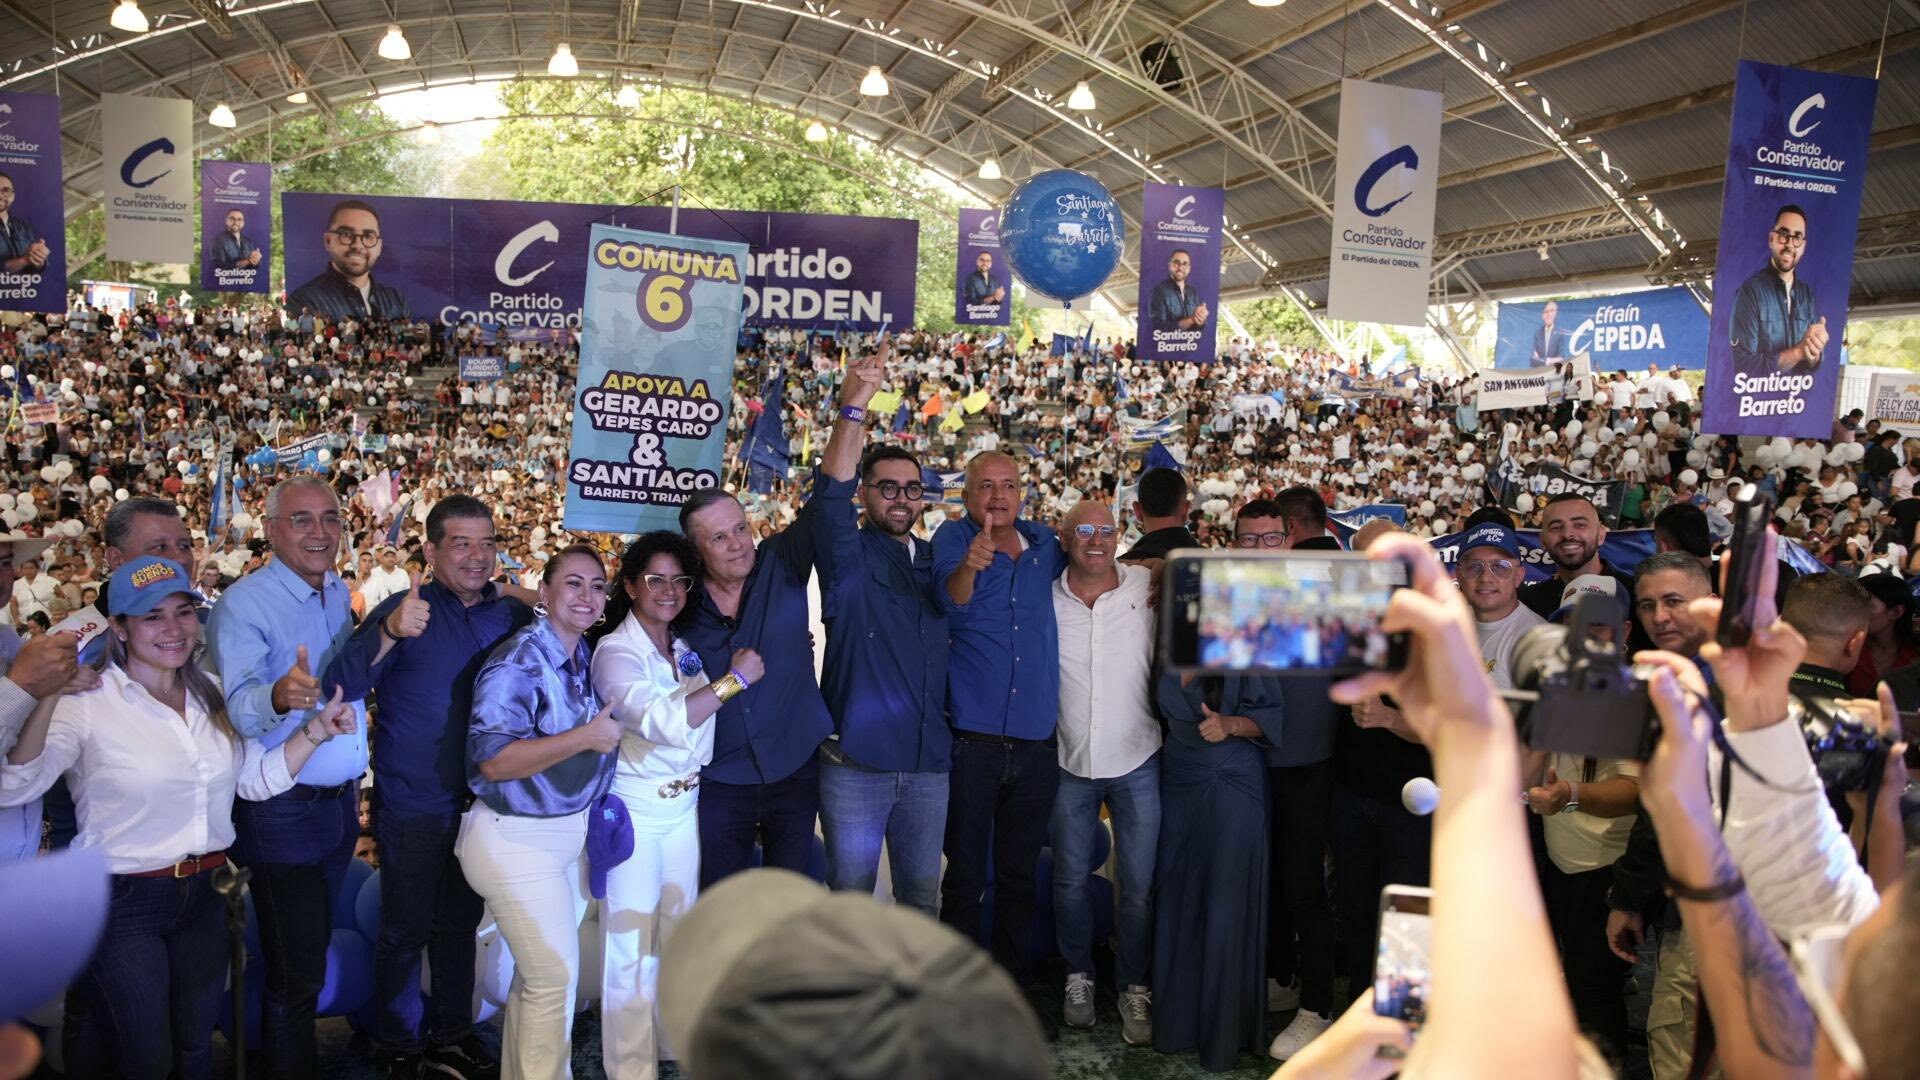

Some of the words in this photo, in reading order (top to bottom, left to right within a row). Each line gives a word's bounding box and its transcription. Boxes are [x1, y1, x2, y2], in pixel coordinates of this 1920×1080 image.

[1783, 139, 1822, 156] Partido
[1756, 146, 1846, 173] Conservador
[1764, 176, 1793, 189] Partido
[1806, 182, 1838, 194] ORDEN.
[113, 196, 188, 210] Conservador
[134, 192, 167, 201] Partido
[1056, 194, 1108, 220] Santiago
[1157, 220, 1210, 233] Conservador
[1367, 223, 1404, 237] Partido
[1343, 229, 1427, 250] Conservador
[596, 241, 738, 281] COMUNA
[1351, 254, 1378, 264] Partido
[1392, 259, 1421, 268] ORDEN.
[214, 267, 257, 278] Santiago
[218, 275, 254, 285] Barreto
[489, 291, 564, 310] Partido
[645, 274, 686, 324] 6
[965, 303, 1000, 313] Santiago
[968, 311, 998, 320] Barreto
[1595, 302, 1640, 325] Efraín
[1152, 328, 1202, 343] Santiago
[1568, 318, 1667, 357] CEPEDA
[1157, 339, 1198, 352] Barreto
[603, 373, 684, 397] APOYA
[690, 382, 708, 399] A
[1483, 380, 1503, 393] SAN
[1504, 376, 1546, 391] ANTONIO
[1732, 370, 1814, 397] Santiago
[583, 390, 720, 422] GERARDO
[1738, 393, 1806, 418] Barreto
[1875, 398, 1904, 411] DELCY
[1903, 399, 1920, 412] ISA
[593, 413, 653, 431] YEPES
[656, 419, 708, 436] CARO
[1875, 410, 1917, 424] SANTIAGO
[632, 432, 664, 469] &
[573, 462, 715, 491] SANTIAGO
[583, 486, 648, 501] BARRETO
[131, 562, 164, 581] SOMOS
[133, 567, 176, 587] BUENOS
